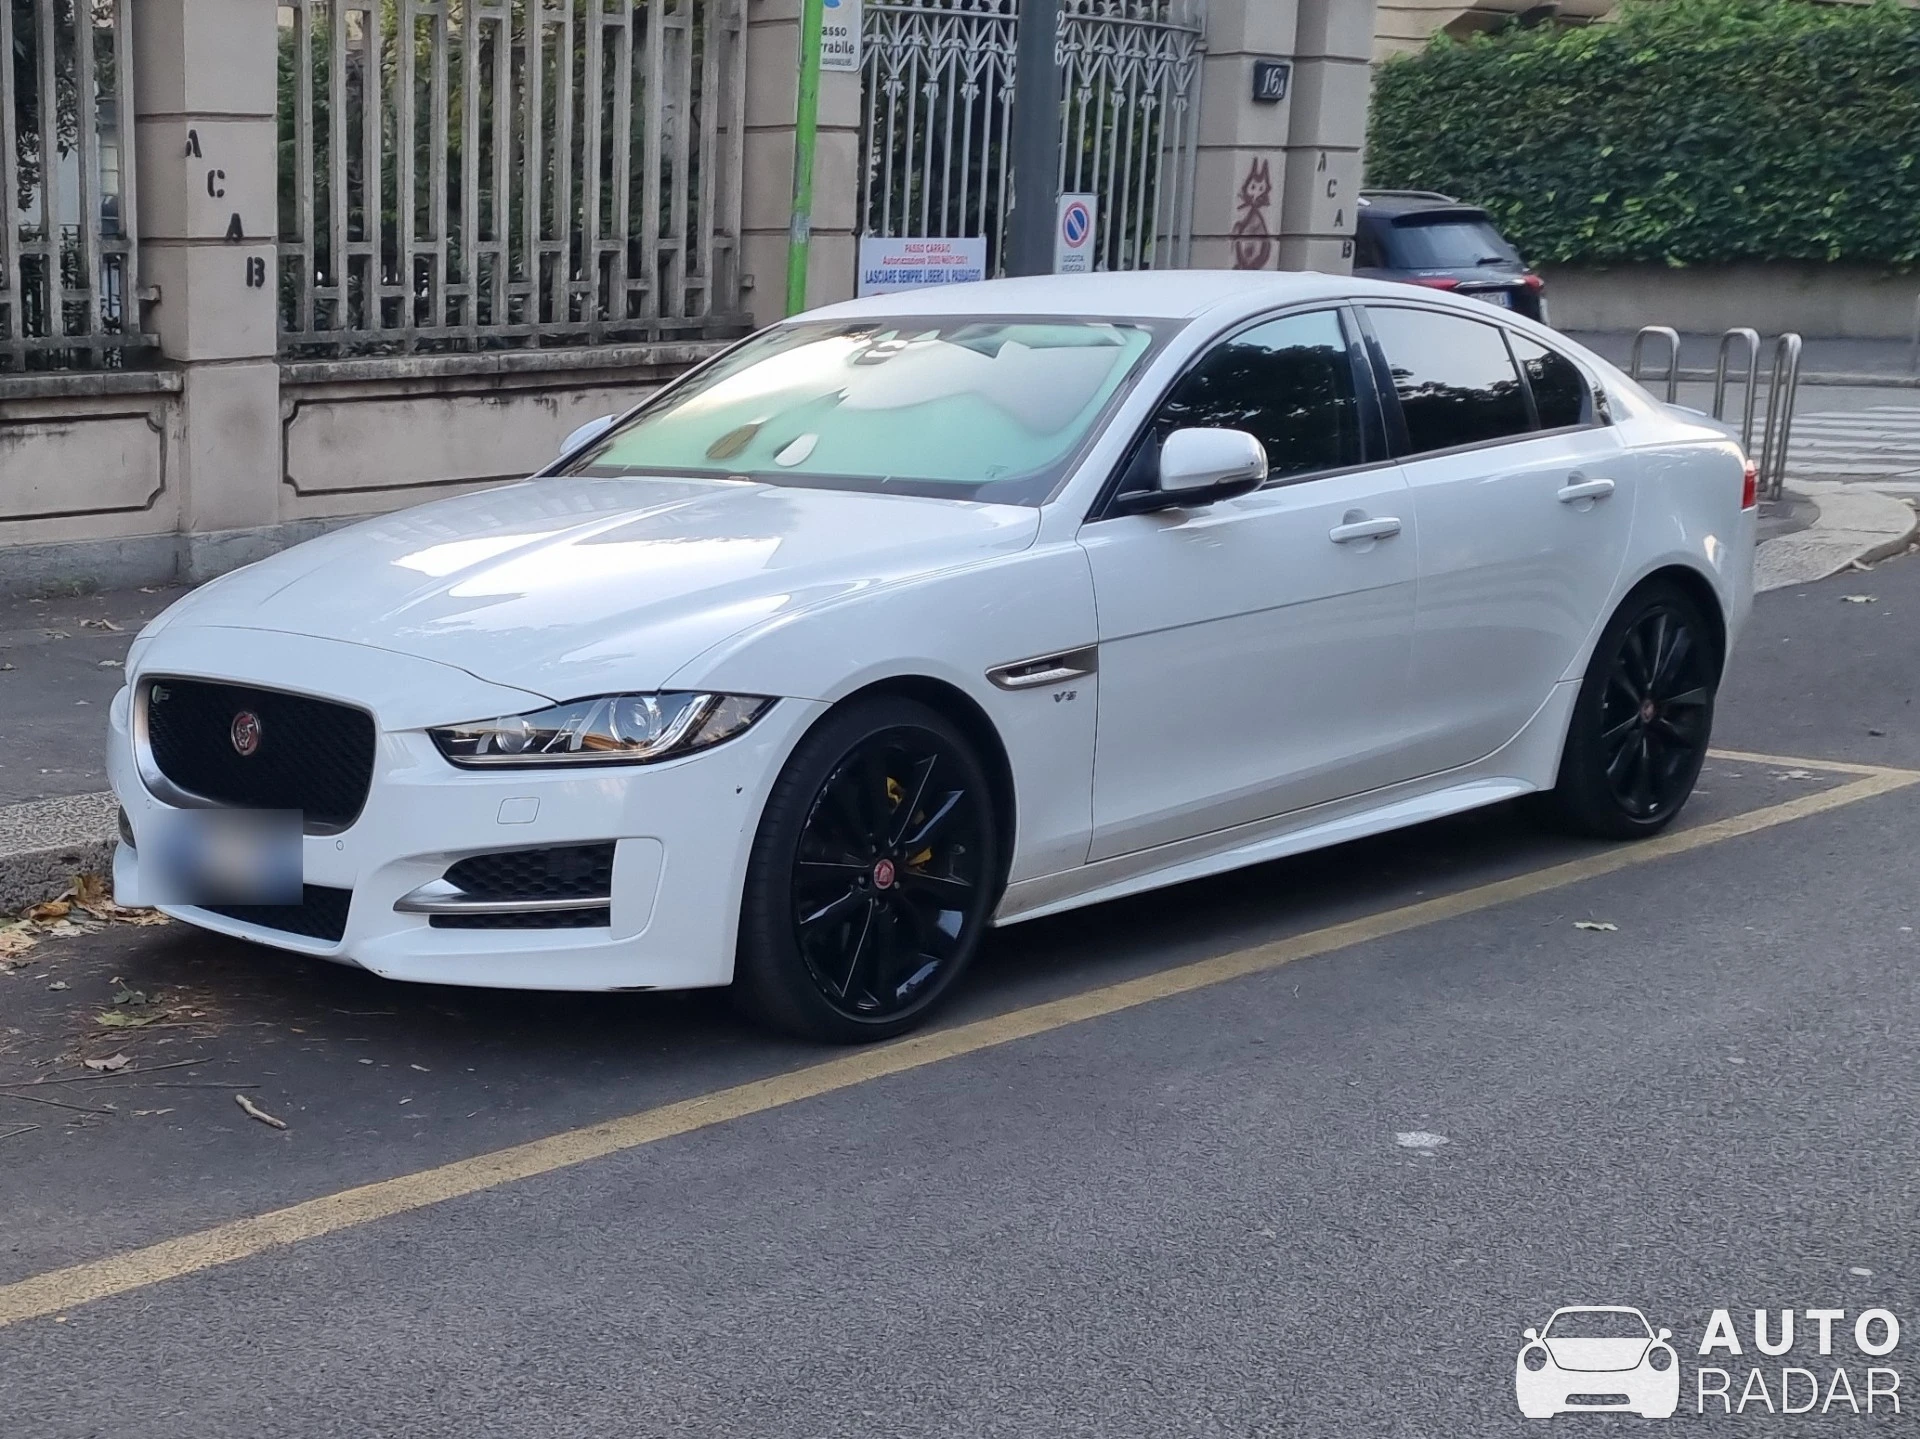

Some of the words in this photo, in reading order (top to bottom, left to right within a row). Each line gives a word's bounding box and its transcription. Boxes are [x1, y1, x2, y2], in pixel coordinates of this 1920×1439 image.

[822, 26, 847, 37] asso
[865, 269, 897, 284] LASCIARE
[898, 269, 922, 283] SEMPRE
[924, 269, 944, 283] LIBERO
